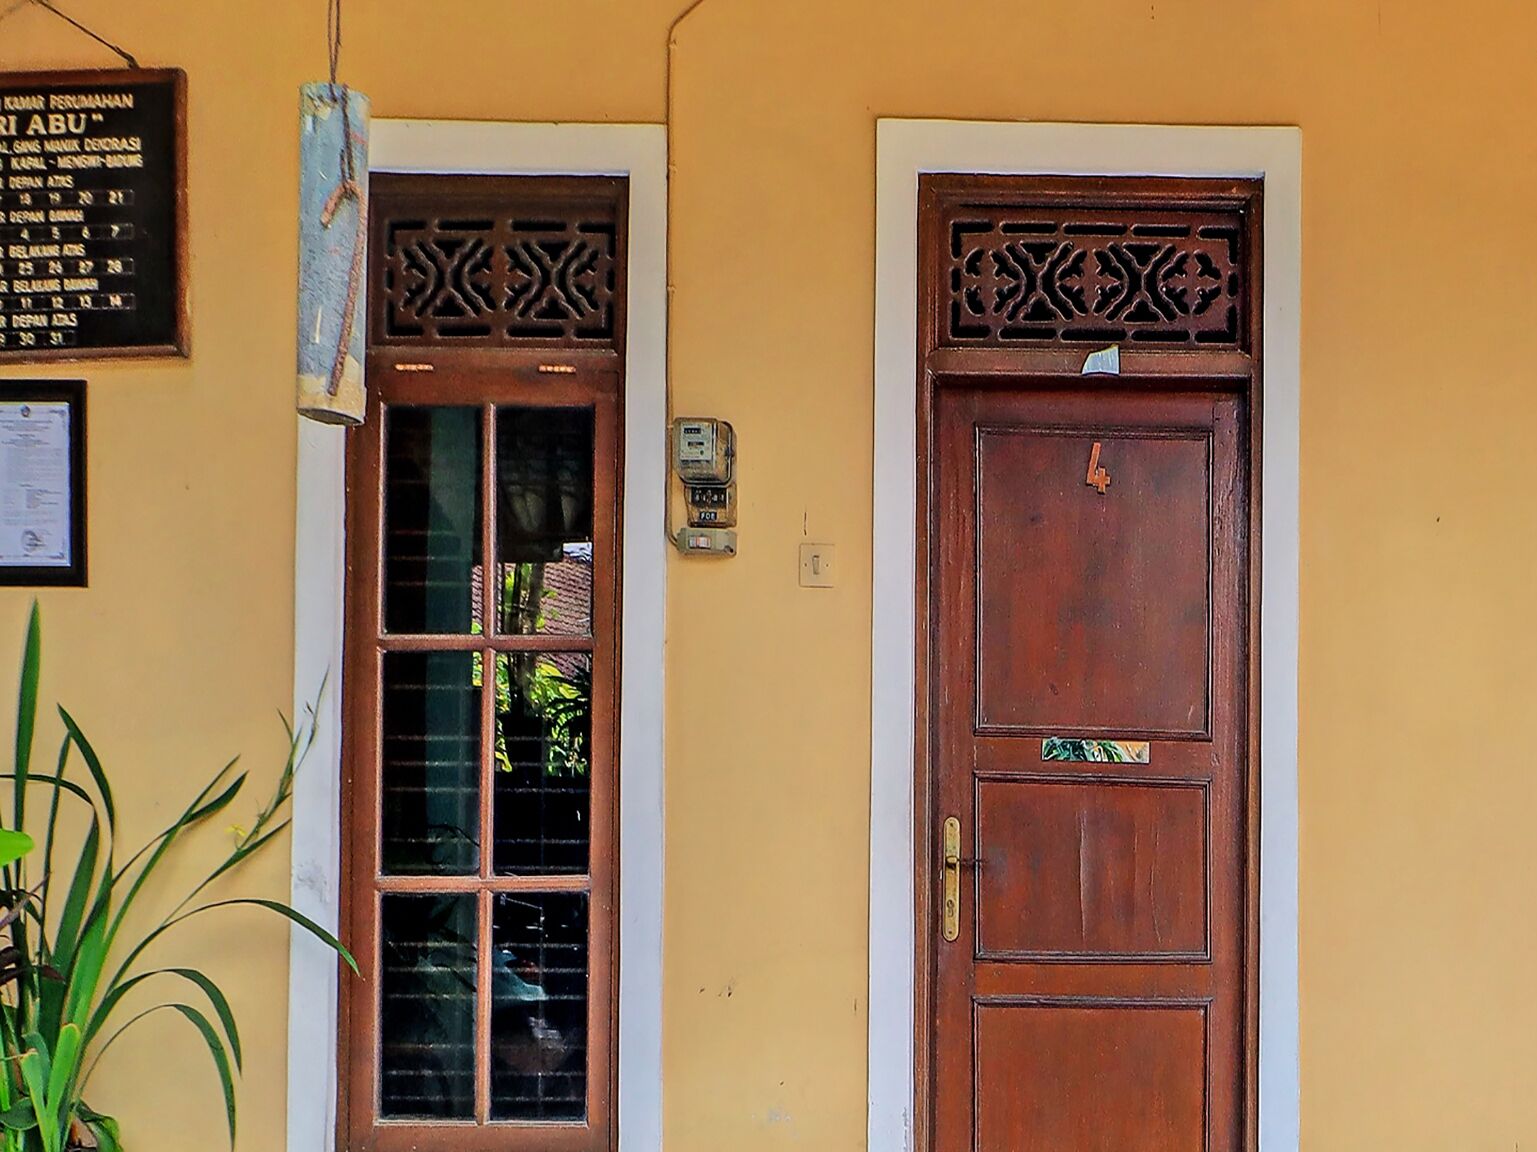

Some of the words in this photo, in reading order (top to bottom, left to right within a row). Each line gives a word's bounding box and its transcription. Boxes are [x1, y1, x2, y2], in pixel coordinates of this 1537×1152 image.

[50, 94, 134, 109] PERUMAHAN
[84, 137, 141, 151] DEKORASI
[9, 176, 43, 189] DEPAN
[47, 175, 74, 188] ATAS
[79, 191, 93, 205] 20
[109, 190, 123, 204] 21
[10, 211, 45, 223] DEPAN
[111, 224, 120, 238] 7
[79, 260, 94, 274] 27
[21, 296, 32, 309] 11
[52, 296, 64, 309] 12
[80, 295, 92, 308] 13
[12, 315, 48, 328] DEPAN
[52, 313, 78, 327] ATAS
[1086, 441, 1111, 494] 4
